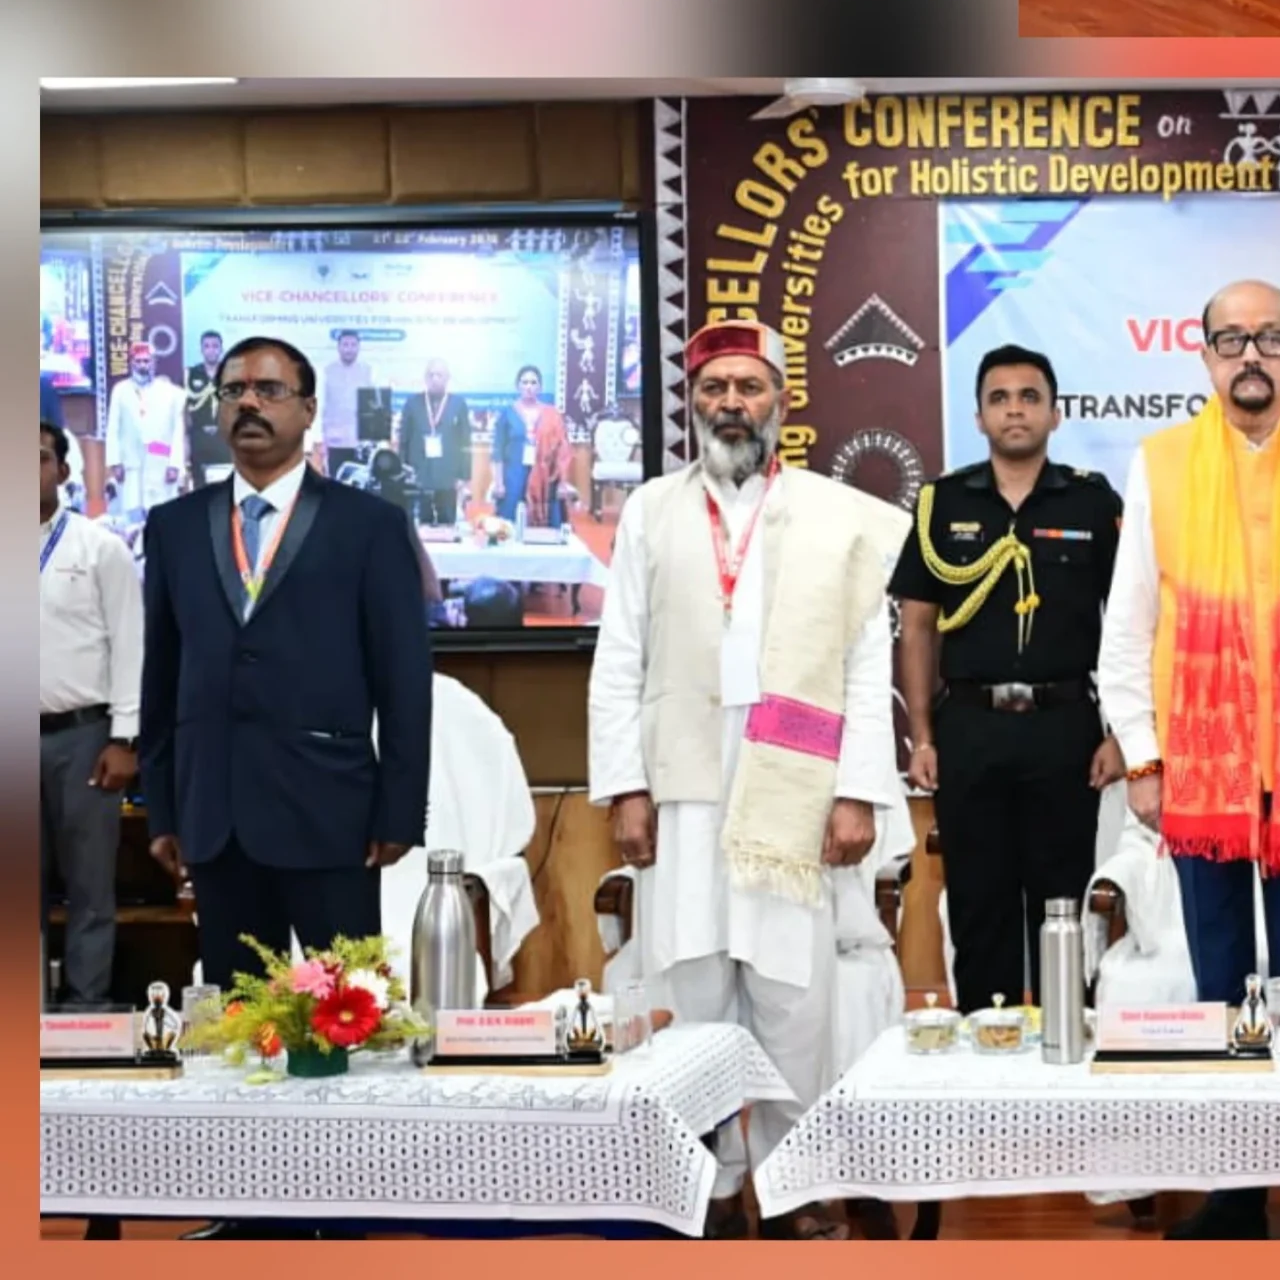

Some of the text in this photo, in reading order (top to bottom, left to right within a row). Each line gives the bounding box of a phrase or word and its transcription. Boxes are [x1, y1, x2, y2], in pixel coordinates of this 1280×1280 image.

[842, 93, 1141, 149] CONFERENCE
[1157, 113, 1193, 138] on
[842, 160, 898, 200] for
[909, 157, 1039, 196] Holistic
[1049, 153, 1274, 202] Development
